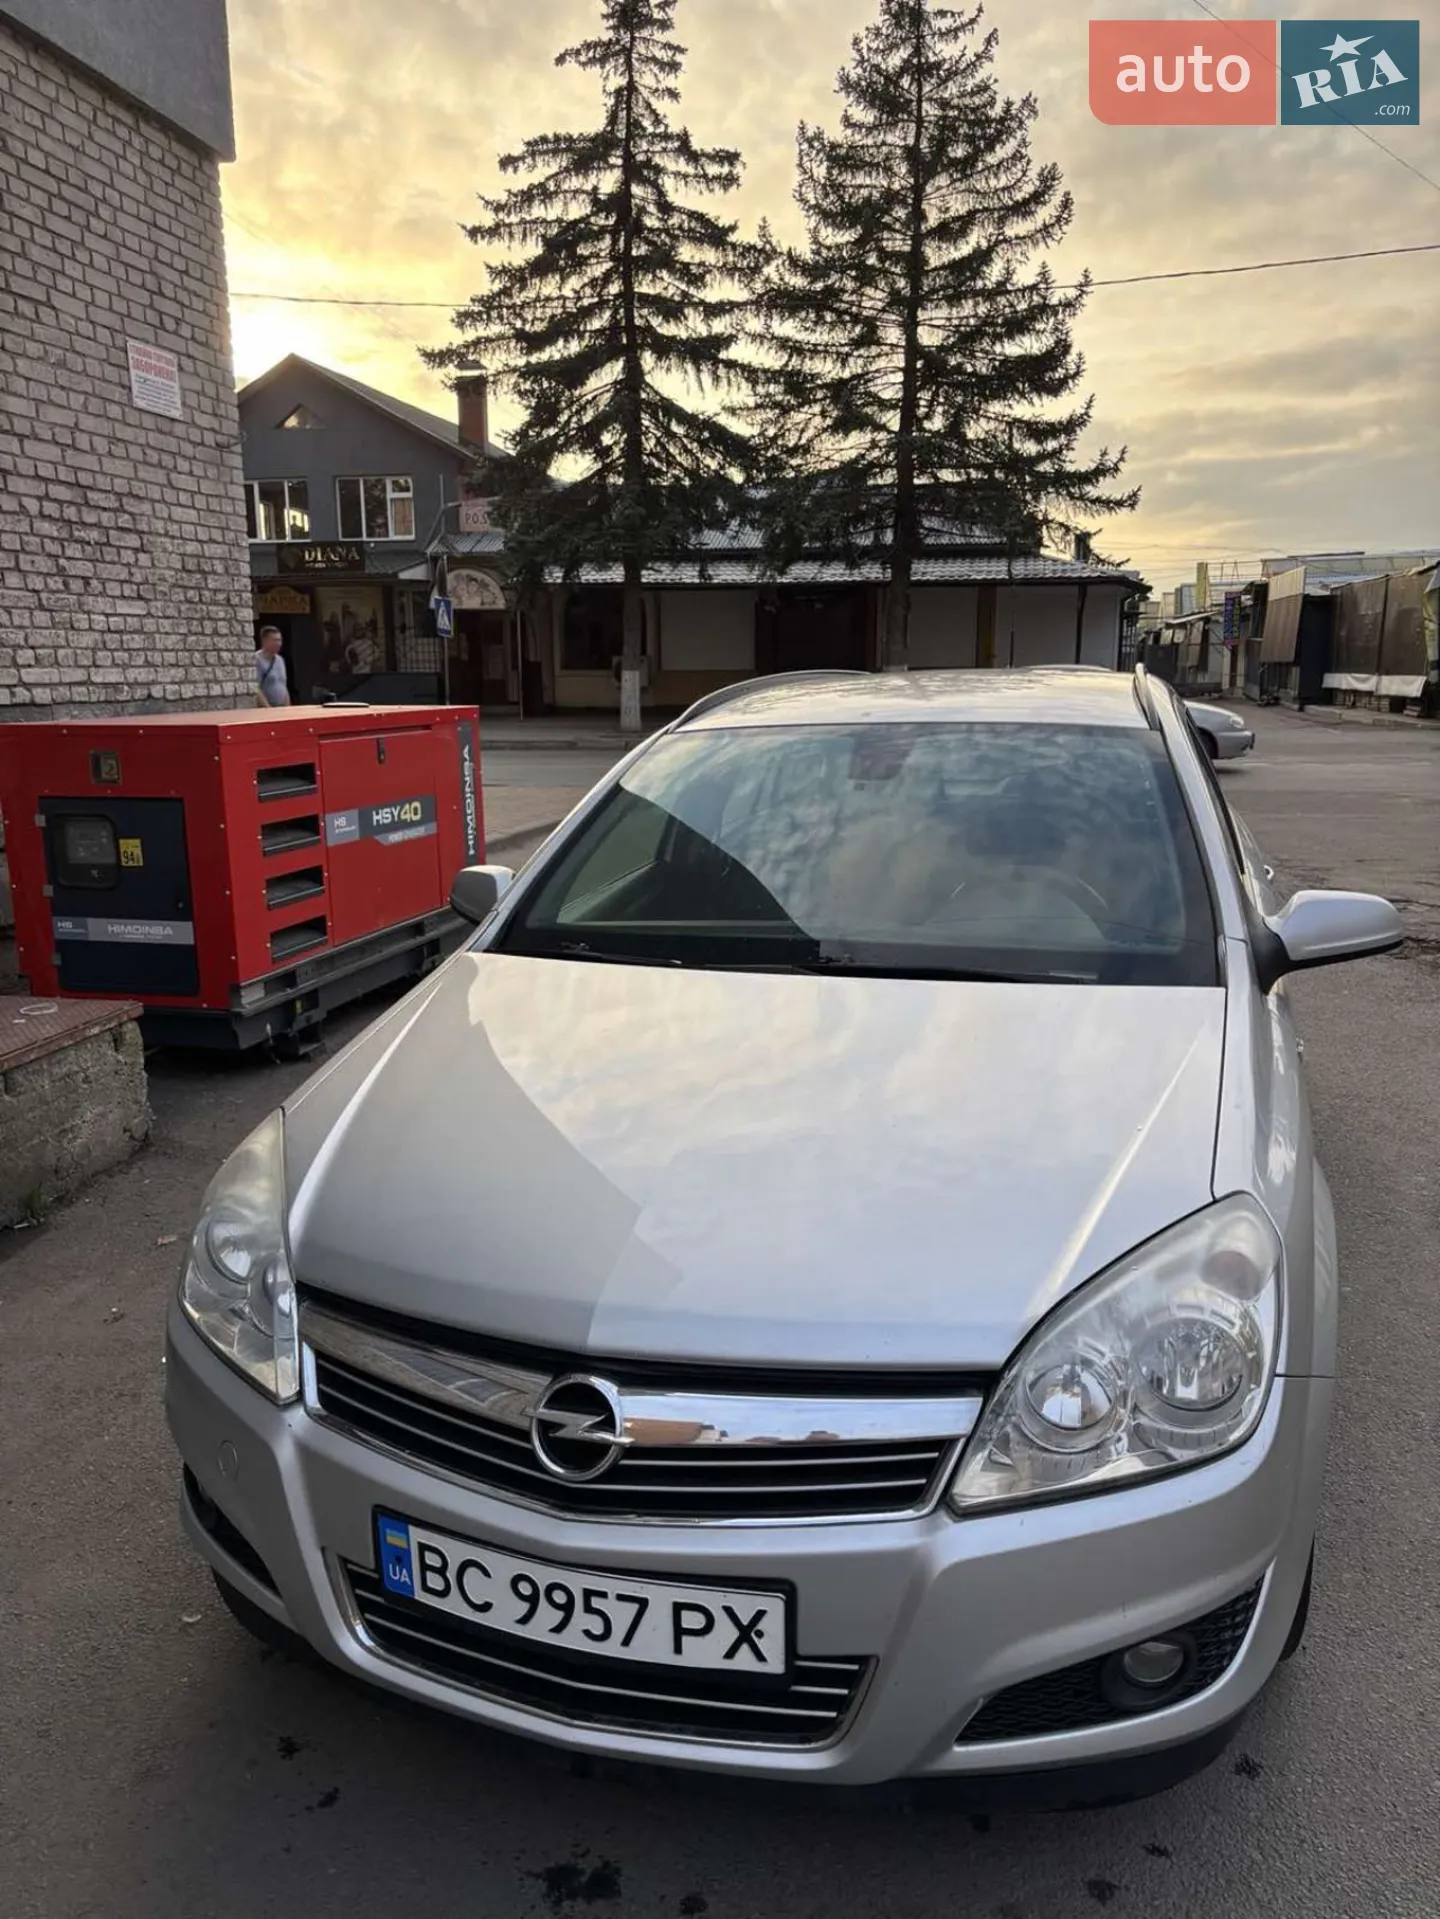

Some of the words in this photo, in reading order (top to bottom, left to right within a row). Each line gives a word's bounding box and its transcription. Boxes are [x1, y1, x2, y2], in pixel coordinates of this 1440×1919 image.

[304, 546, 360, 561] DIANA
[372, 801, 422, 826] HSY40
[388, 1563, 411, 1585] UA
[417, 1540, 494, 1613] BC
[510, 1573, 650, 1647] 9957
[672, 1600, 769, 1663] PX
